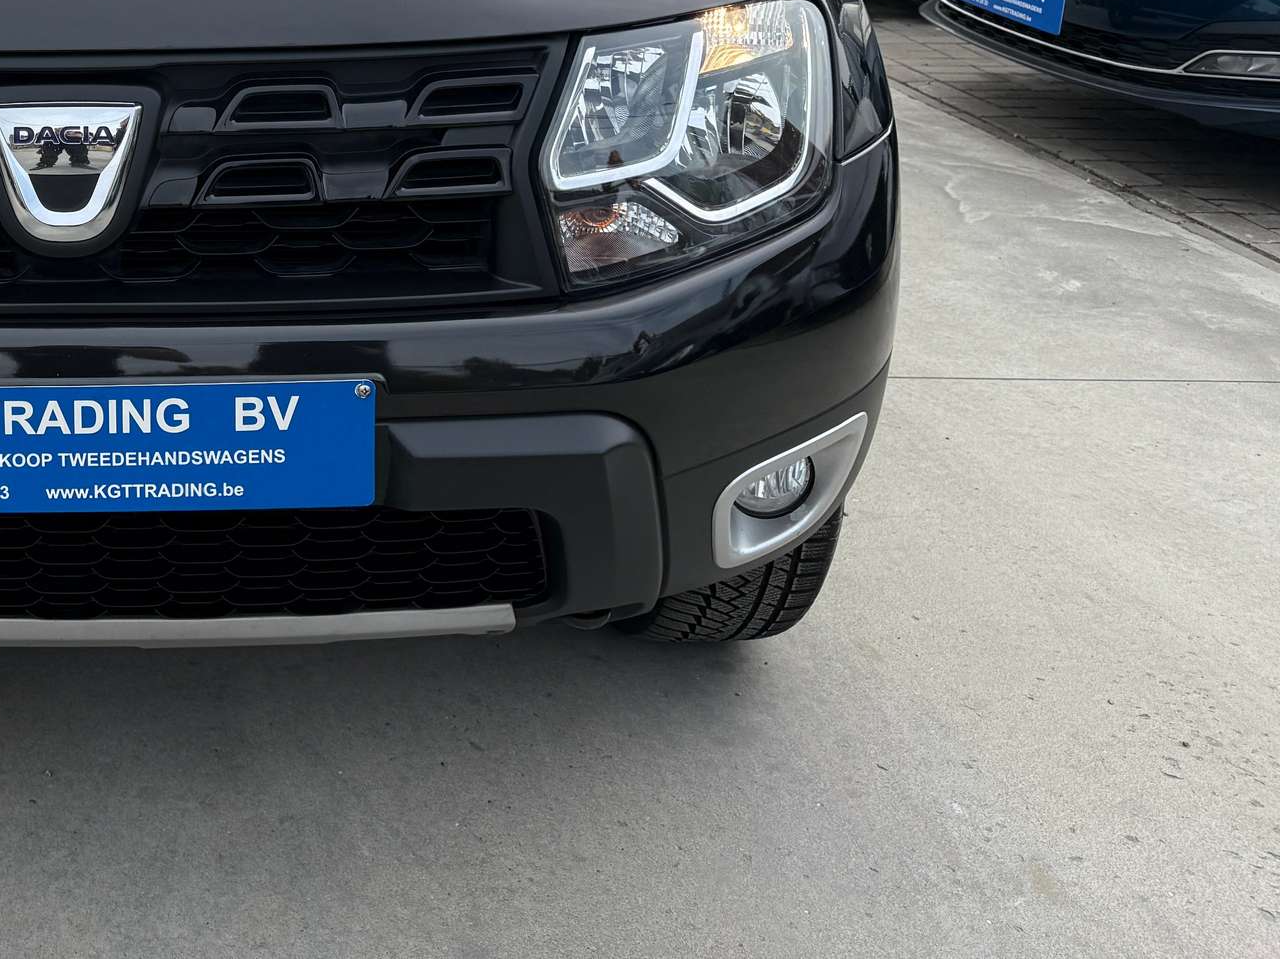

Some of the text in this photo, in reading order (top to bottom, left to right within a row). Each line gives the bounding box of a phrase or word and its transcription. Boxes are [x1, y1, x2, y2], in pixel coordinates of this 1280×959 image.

[13, 125, 115, 145] DACIA
[234, 395, 300, 432] BV
[58, 449, 286, 467] TWEEDEHANDSWAGENS
[46, 482, 244, 500] www.KGTTRADING.be
